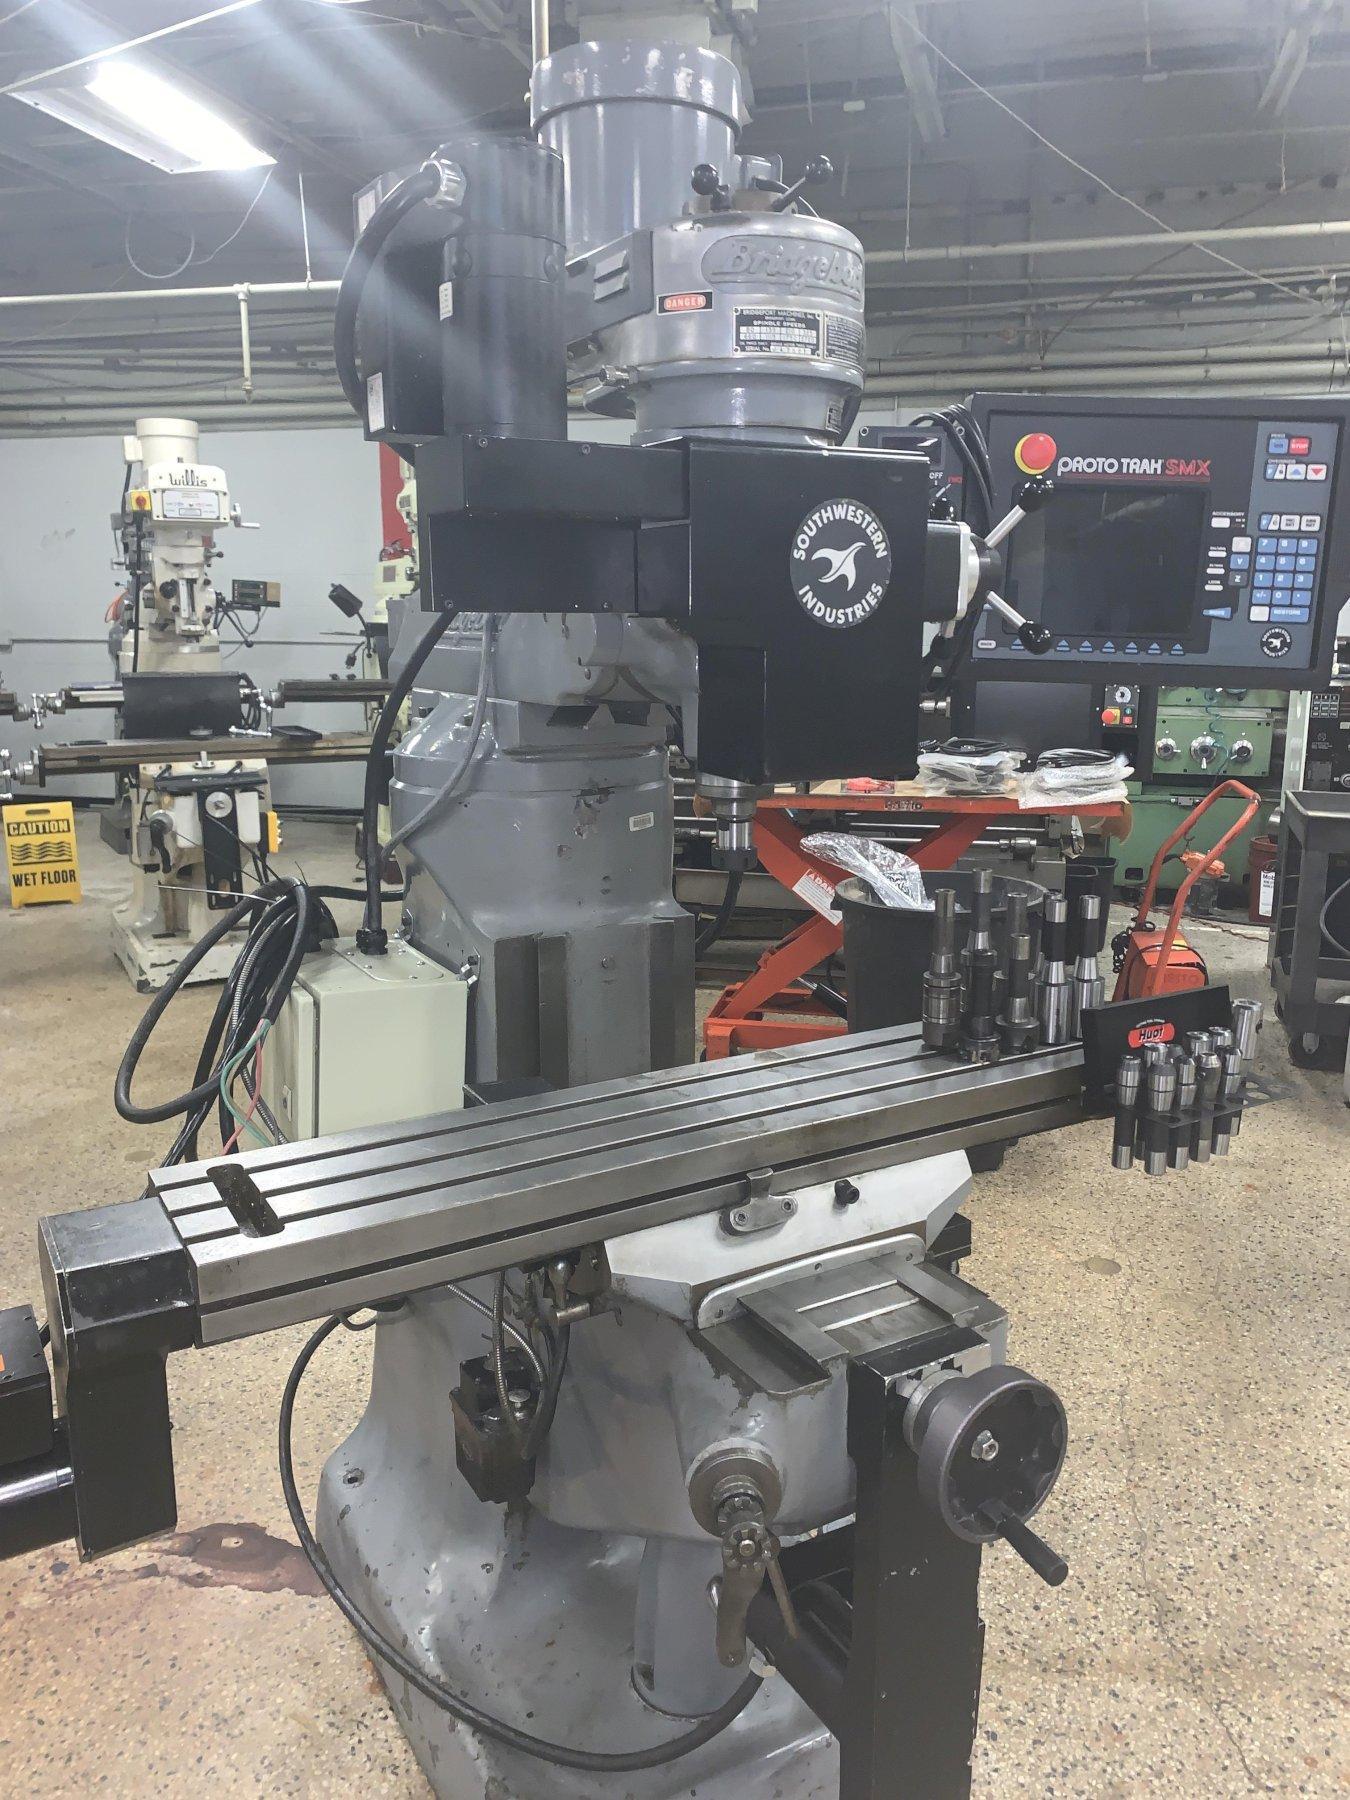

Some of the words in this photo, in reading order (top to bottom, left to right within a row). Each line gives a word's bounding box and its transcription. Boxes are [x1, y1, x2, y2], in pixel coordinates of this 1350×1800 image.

[665, 297, 704, 308] DANGER
[1057, 457, 1118, 476] PROTO
[1165, 459, 1211, 476] SMX
[793, 503, 888, 561] SOUTHWESTERN
[798, 582, 883, 624] INDUSTRIES
[9, 821, 69, 836] CAUTION
[13, 872, 37, 887] WET
[41, 869, 77, 885] FLOOR
